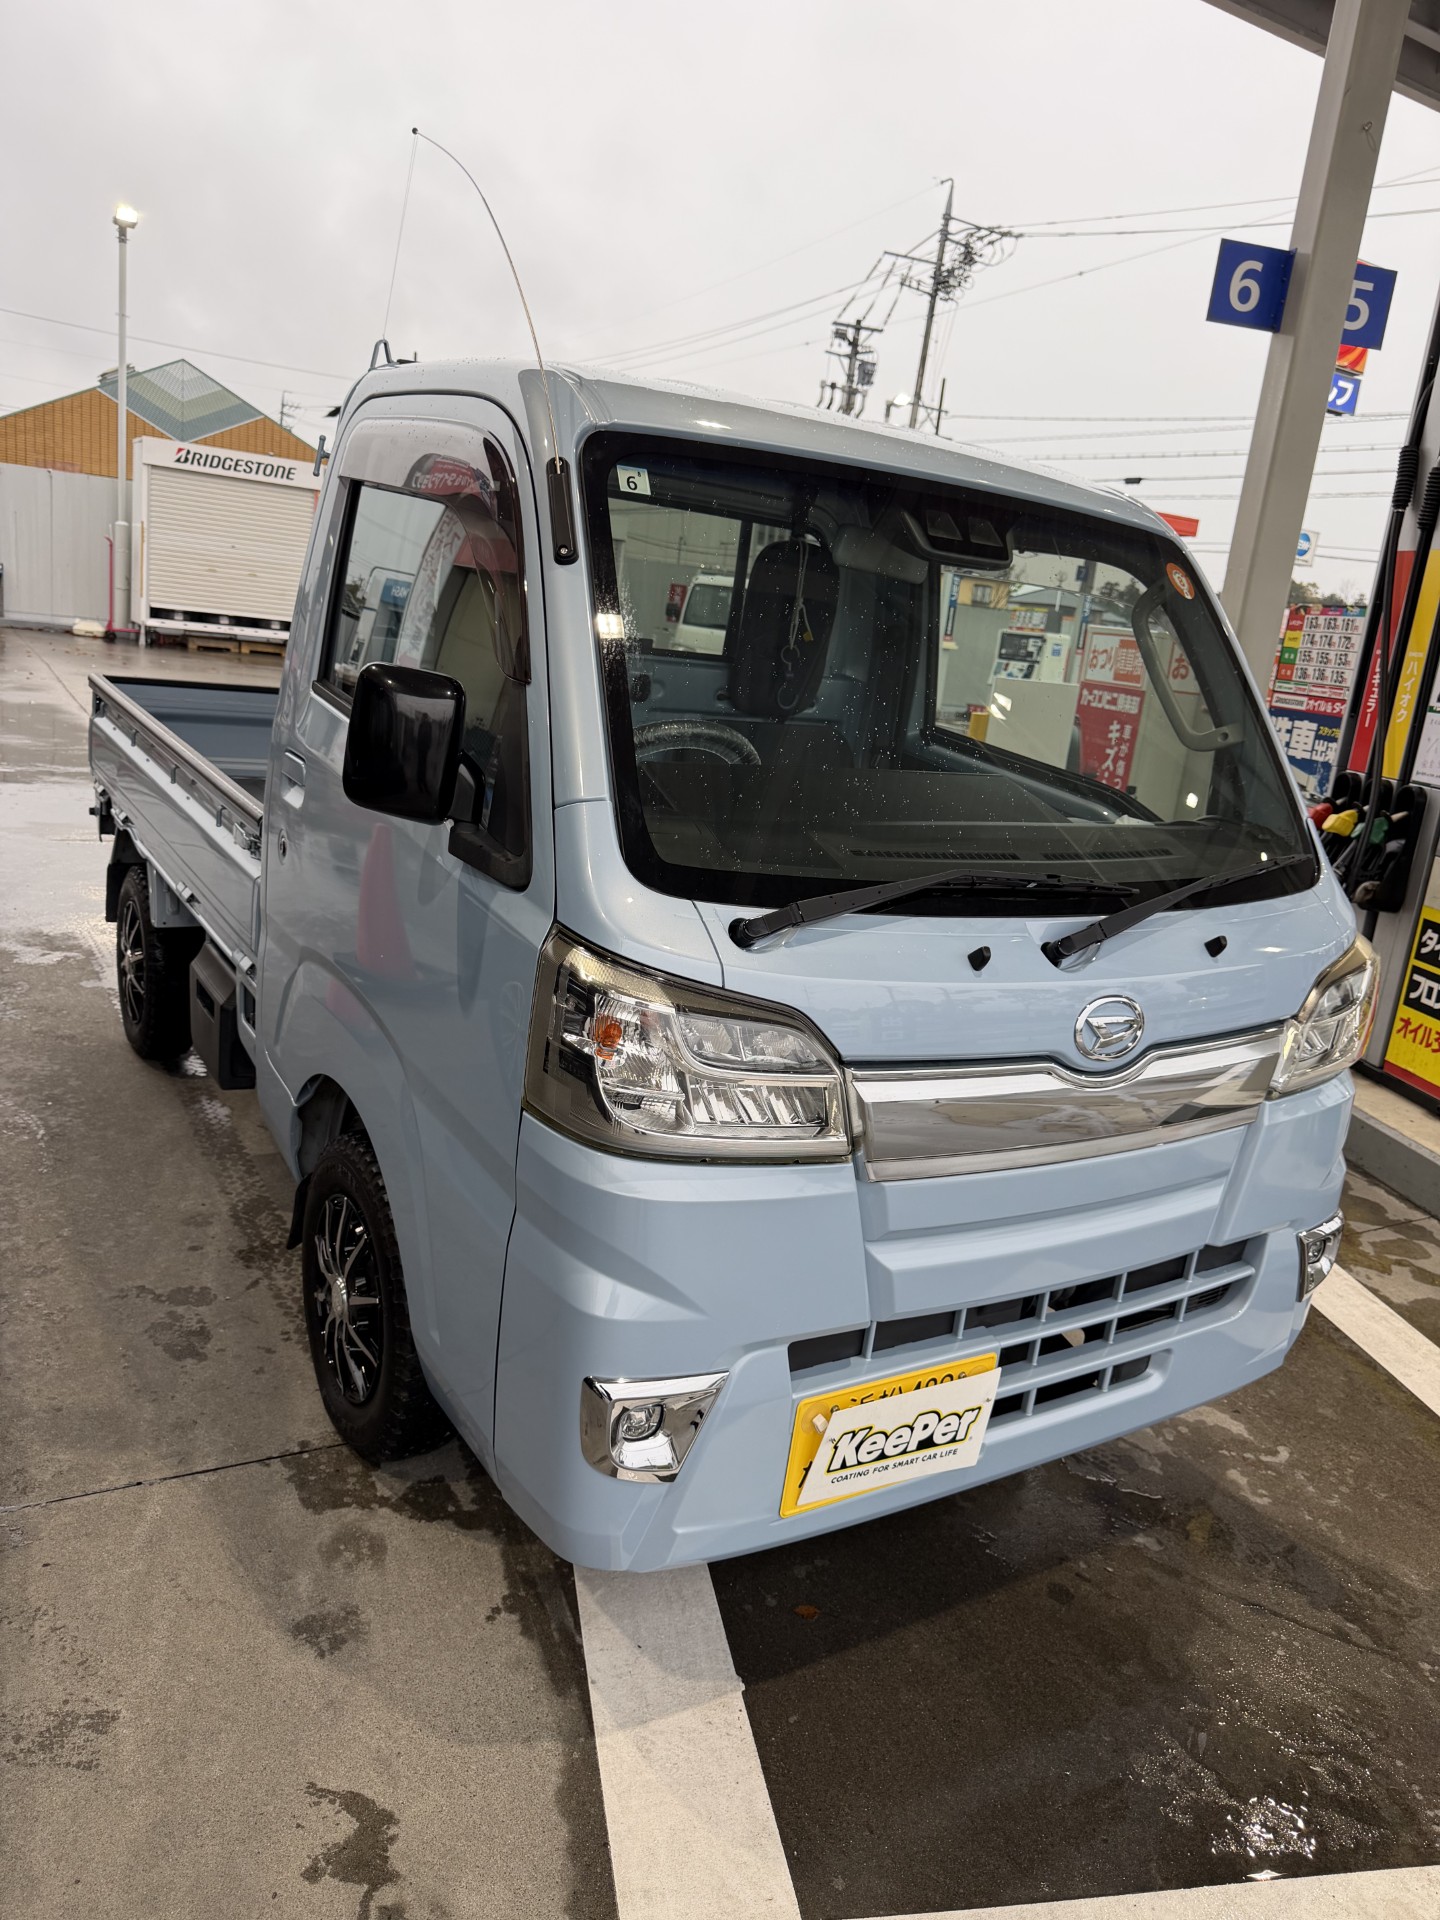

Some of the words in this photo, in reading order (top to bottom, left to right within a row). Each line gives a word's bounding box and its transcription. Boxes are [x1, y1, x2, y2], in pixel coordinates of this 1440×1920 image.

[1228, 260, 1264, 312] 6
[1343, 279, 1375, 331] 5
[174, 447, 297, 481] BRIDGESTONE
[626, 476, 638, 491] 6
[1396, 661, 1418, 723] ハイオク
[826, 1405, 982, 1474] KeePer
[830, 1469, 870, 1484] COATING
[872, 1464, 889, 1474] FOR
[892, 1457, 919, 1470] SMART
[921, 1452, 938, 1463] CAR
[940, 1448, 958, 1459] LIFE
